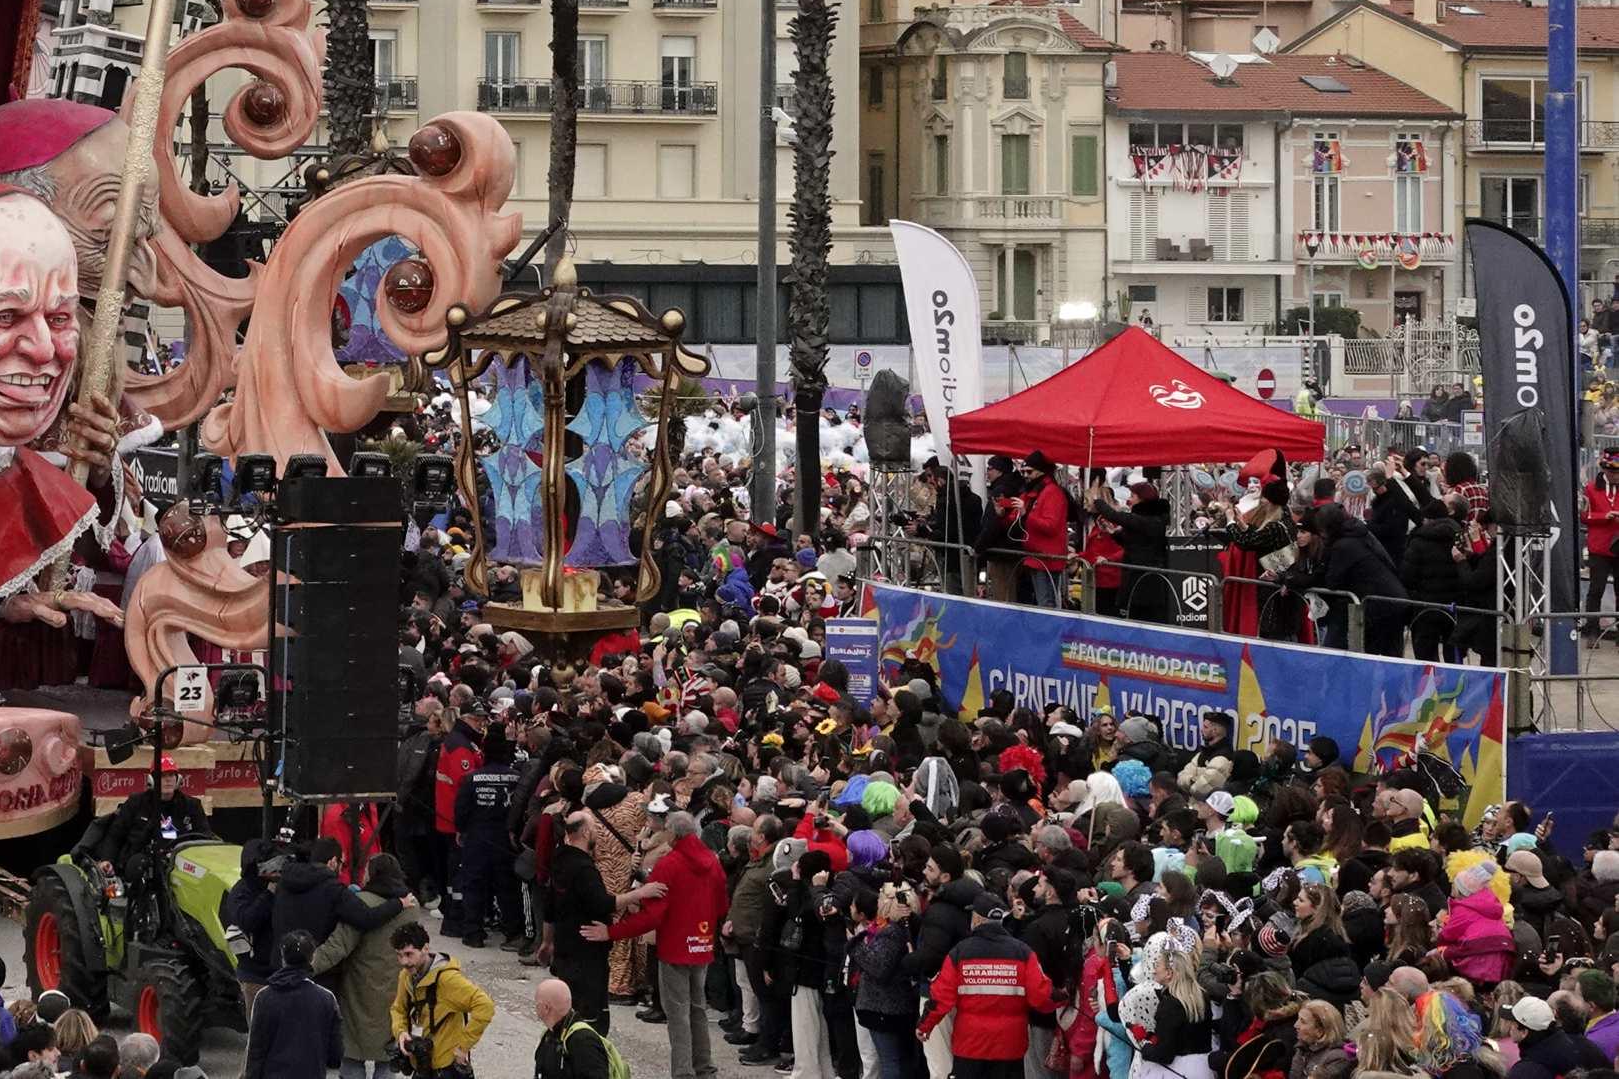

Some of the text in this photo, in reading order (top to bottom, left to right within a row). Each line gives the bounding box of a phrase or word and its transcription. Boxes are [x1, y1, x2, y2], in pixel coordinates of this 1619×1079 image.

[1176, 613, 1207, 622] radiom
[1068, 641, 1221, 684] #FACCIAMOPACE
[180, 687, 202, 701] 23
[1246, 712, 1317, 761] 2025
[963, 977, 1018, 985] VOLONTARIATO
